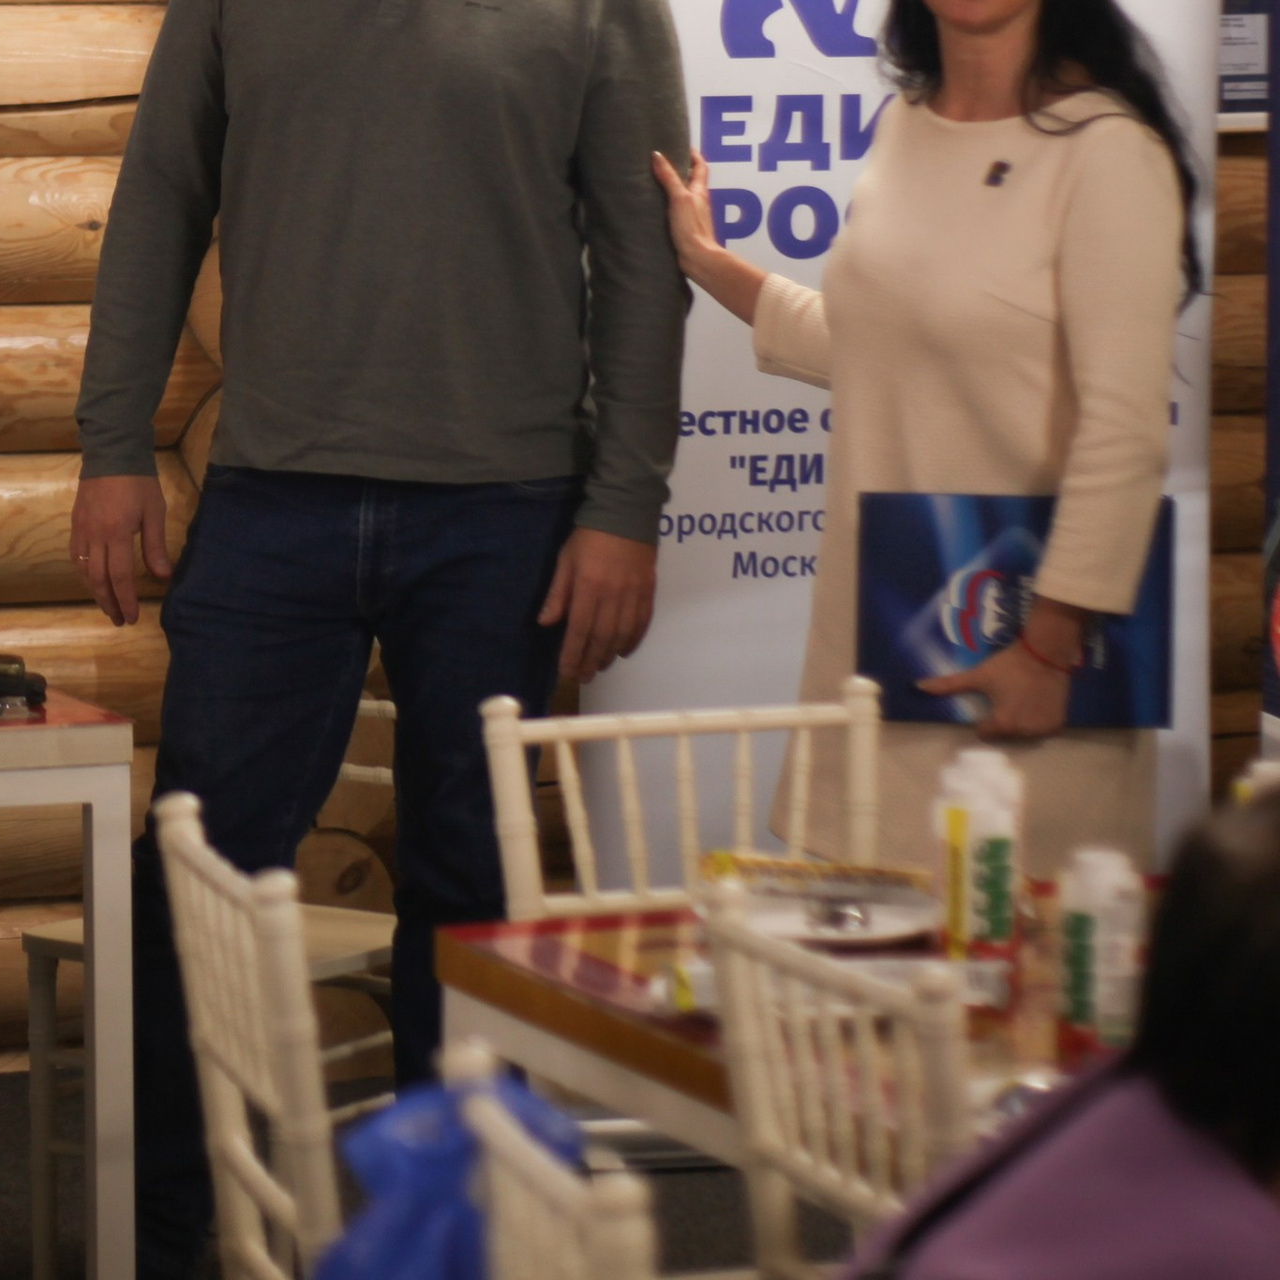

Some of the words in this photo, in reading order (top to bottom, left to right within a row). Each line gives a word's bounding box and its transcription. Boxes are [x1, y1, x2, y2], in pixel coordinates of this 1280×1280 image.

[700, 93, 896, 172] ЕДИ
[708, 185, 854, 260] РО
[678, 407, 810, 437] естное
[730, 453, 824, 493] "ЕДИ
[658, 509, 826, 543] ородского
[731, 550, 818, 579] Моск
